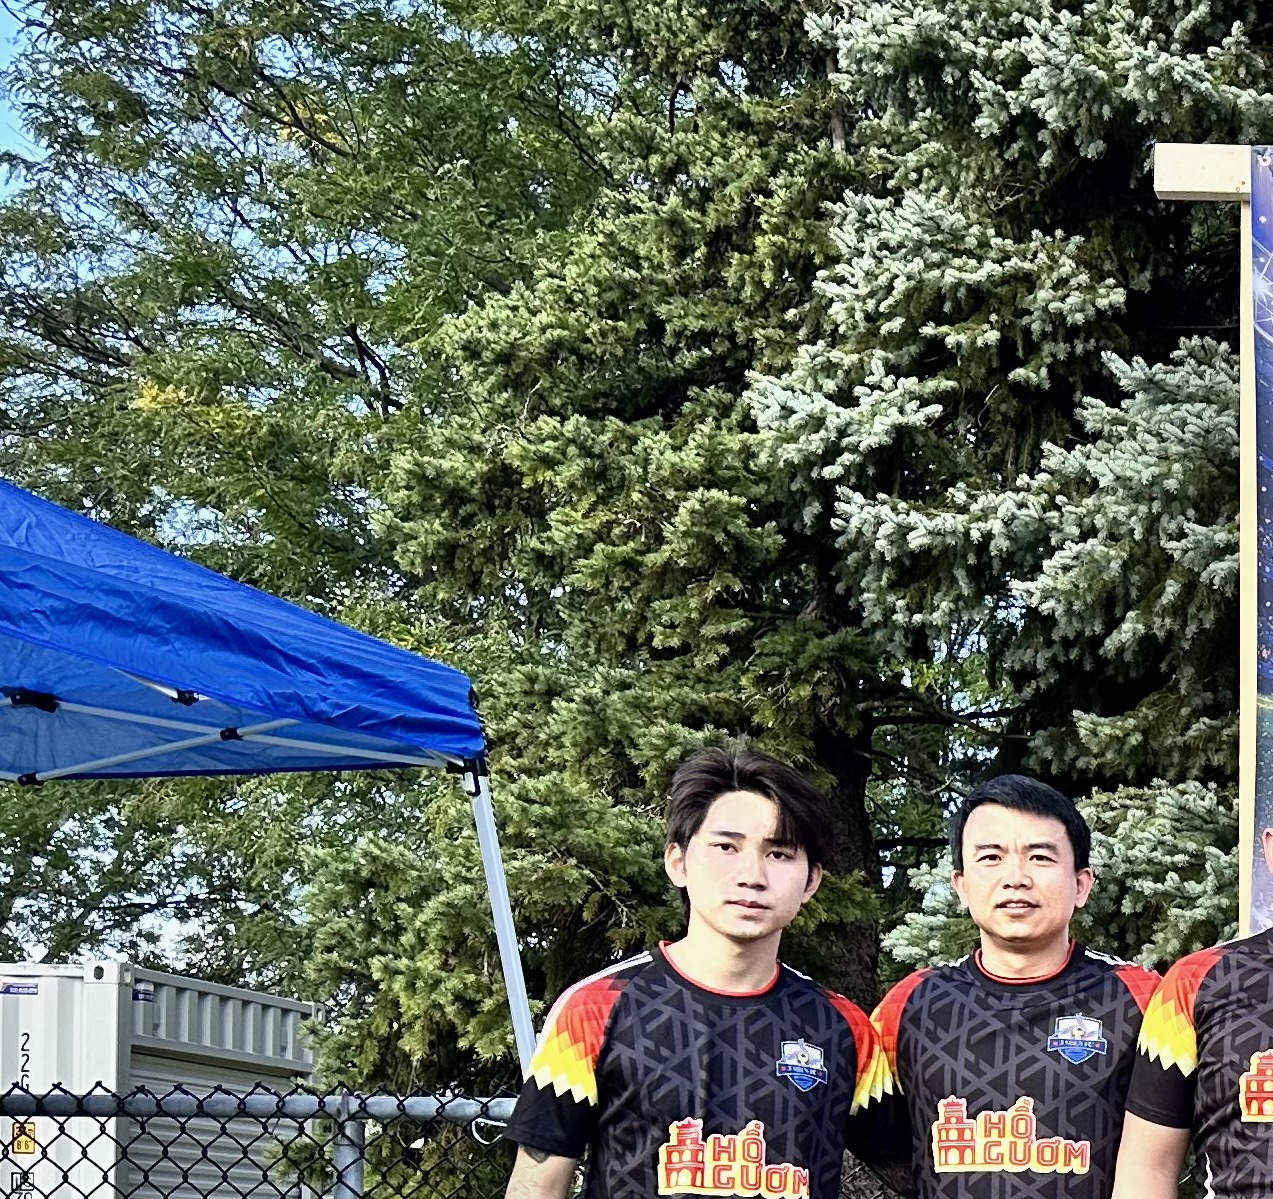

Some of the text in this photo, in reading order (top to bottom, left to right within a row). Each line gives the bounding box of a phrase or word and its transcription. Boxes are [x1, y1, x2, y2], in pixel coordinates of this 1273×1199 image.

[983, 1100, 1036, 1141] HỒ
[712, 1122, 764, 1164] HỒ
[983, 1137, 1089, 1170] GƯƠM
